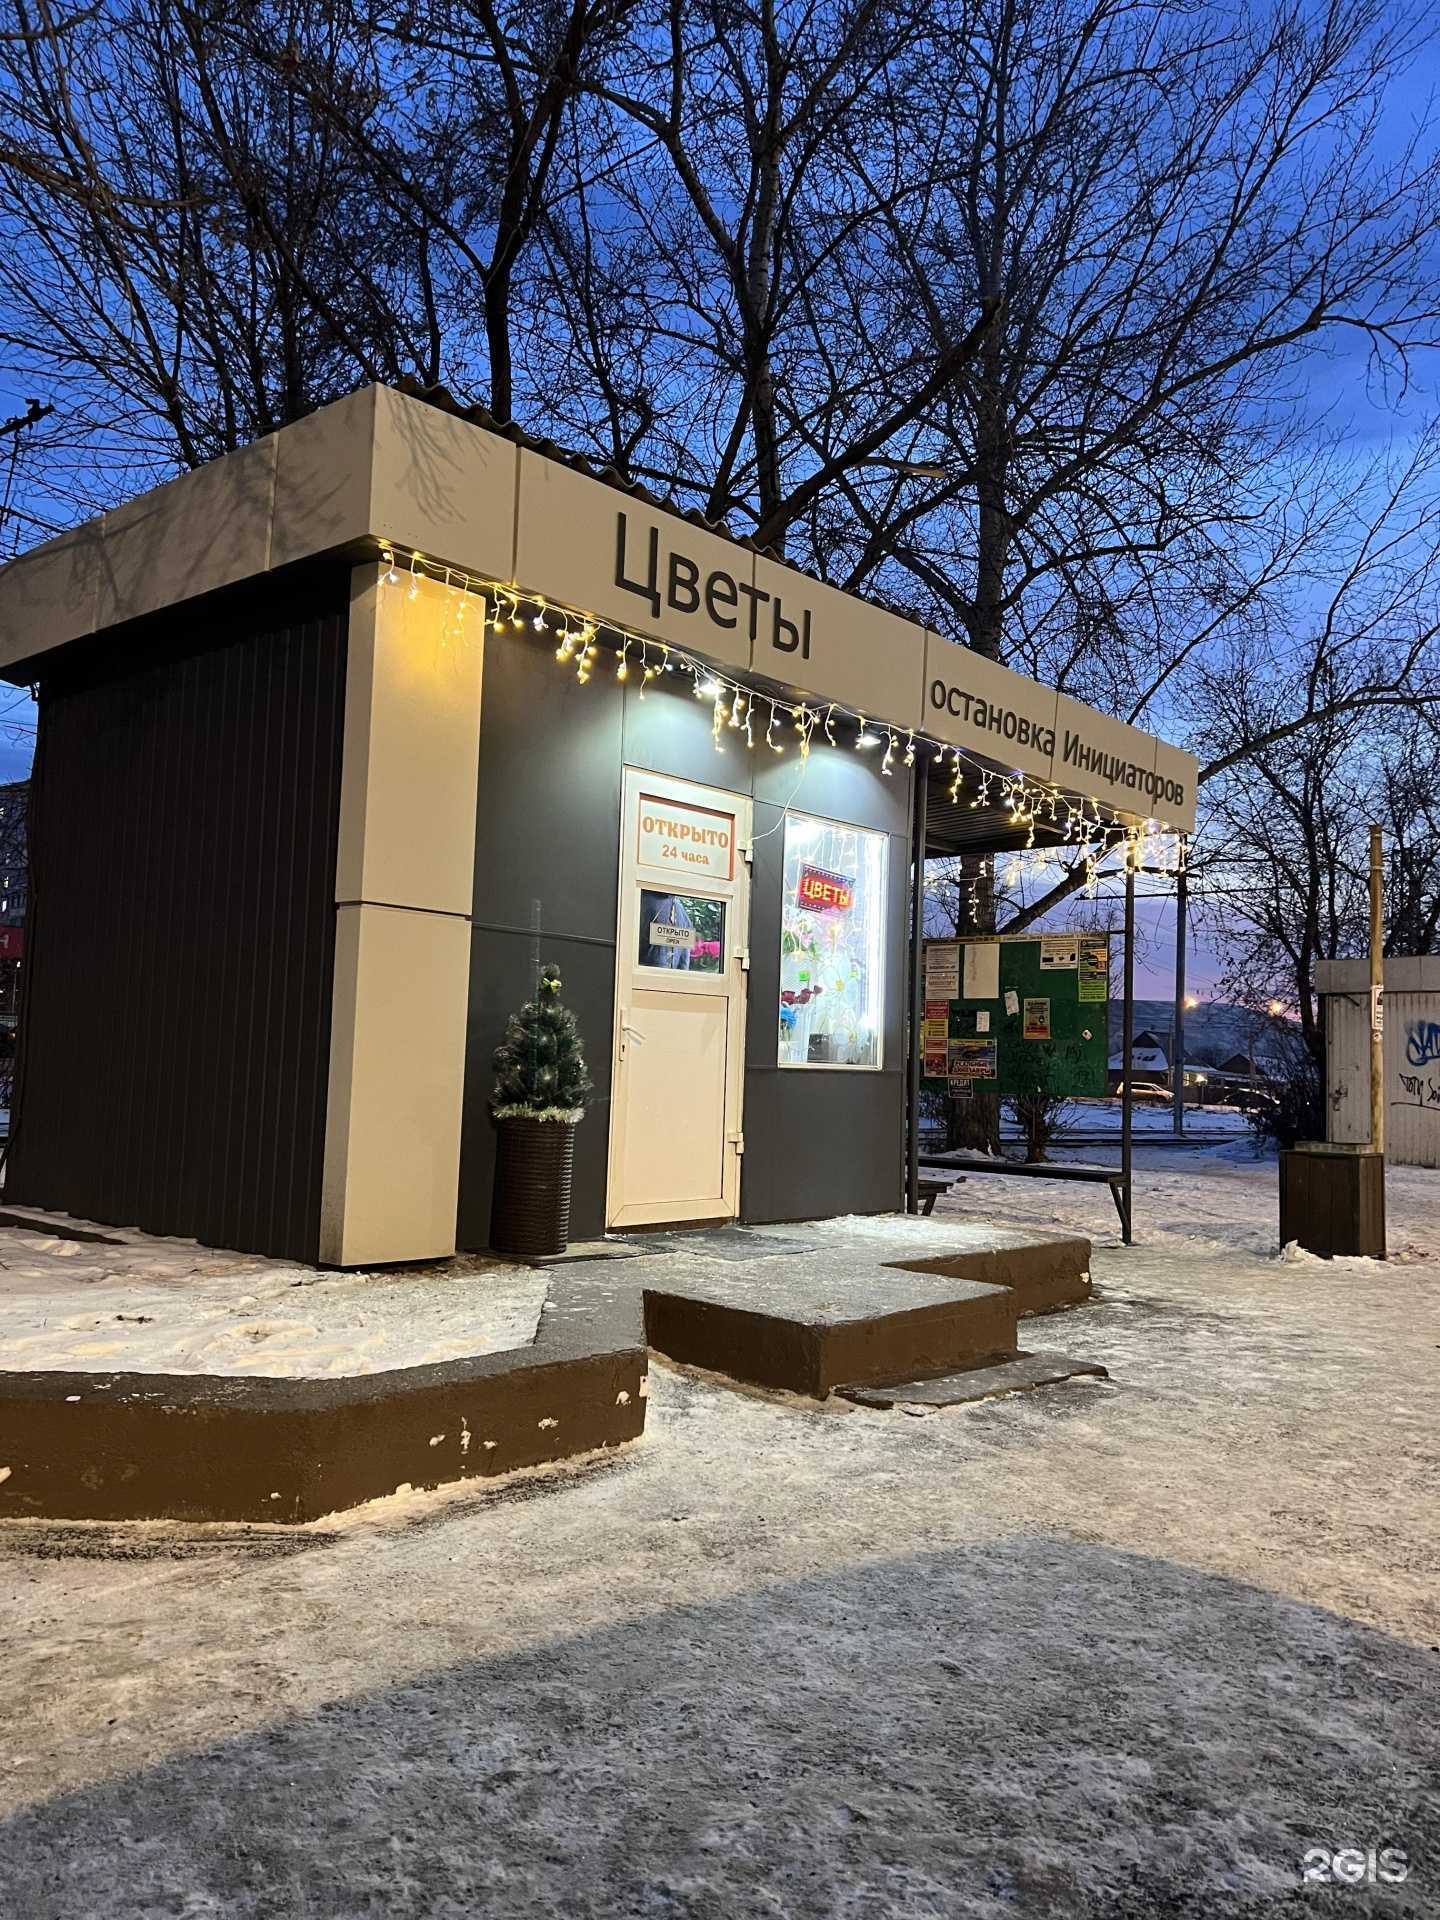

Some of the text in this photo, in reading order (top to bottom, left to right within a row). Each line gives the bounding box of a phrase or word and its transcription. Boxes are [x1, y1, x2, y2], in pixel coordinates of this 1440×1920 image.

[615, 512, 812, 660] Цветы
[930, 679, 1184, 806] остановка Инициаторов
[642, 816, 729, 848] ОТКРЫТО
[662, 844, 710, 865] 24 часа
[803, 878, 849, 906] ЦВЕТЫ
[657, 926, 690, 939] ОТКРЫТО
